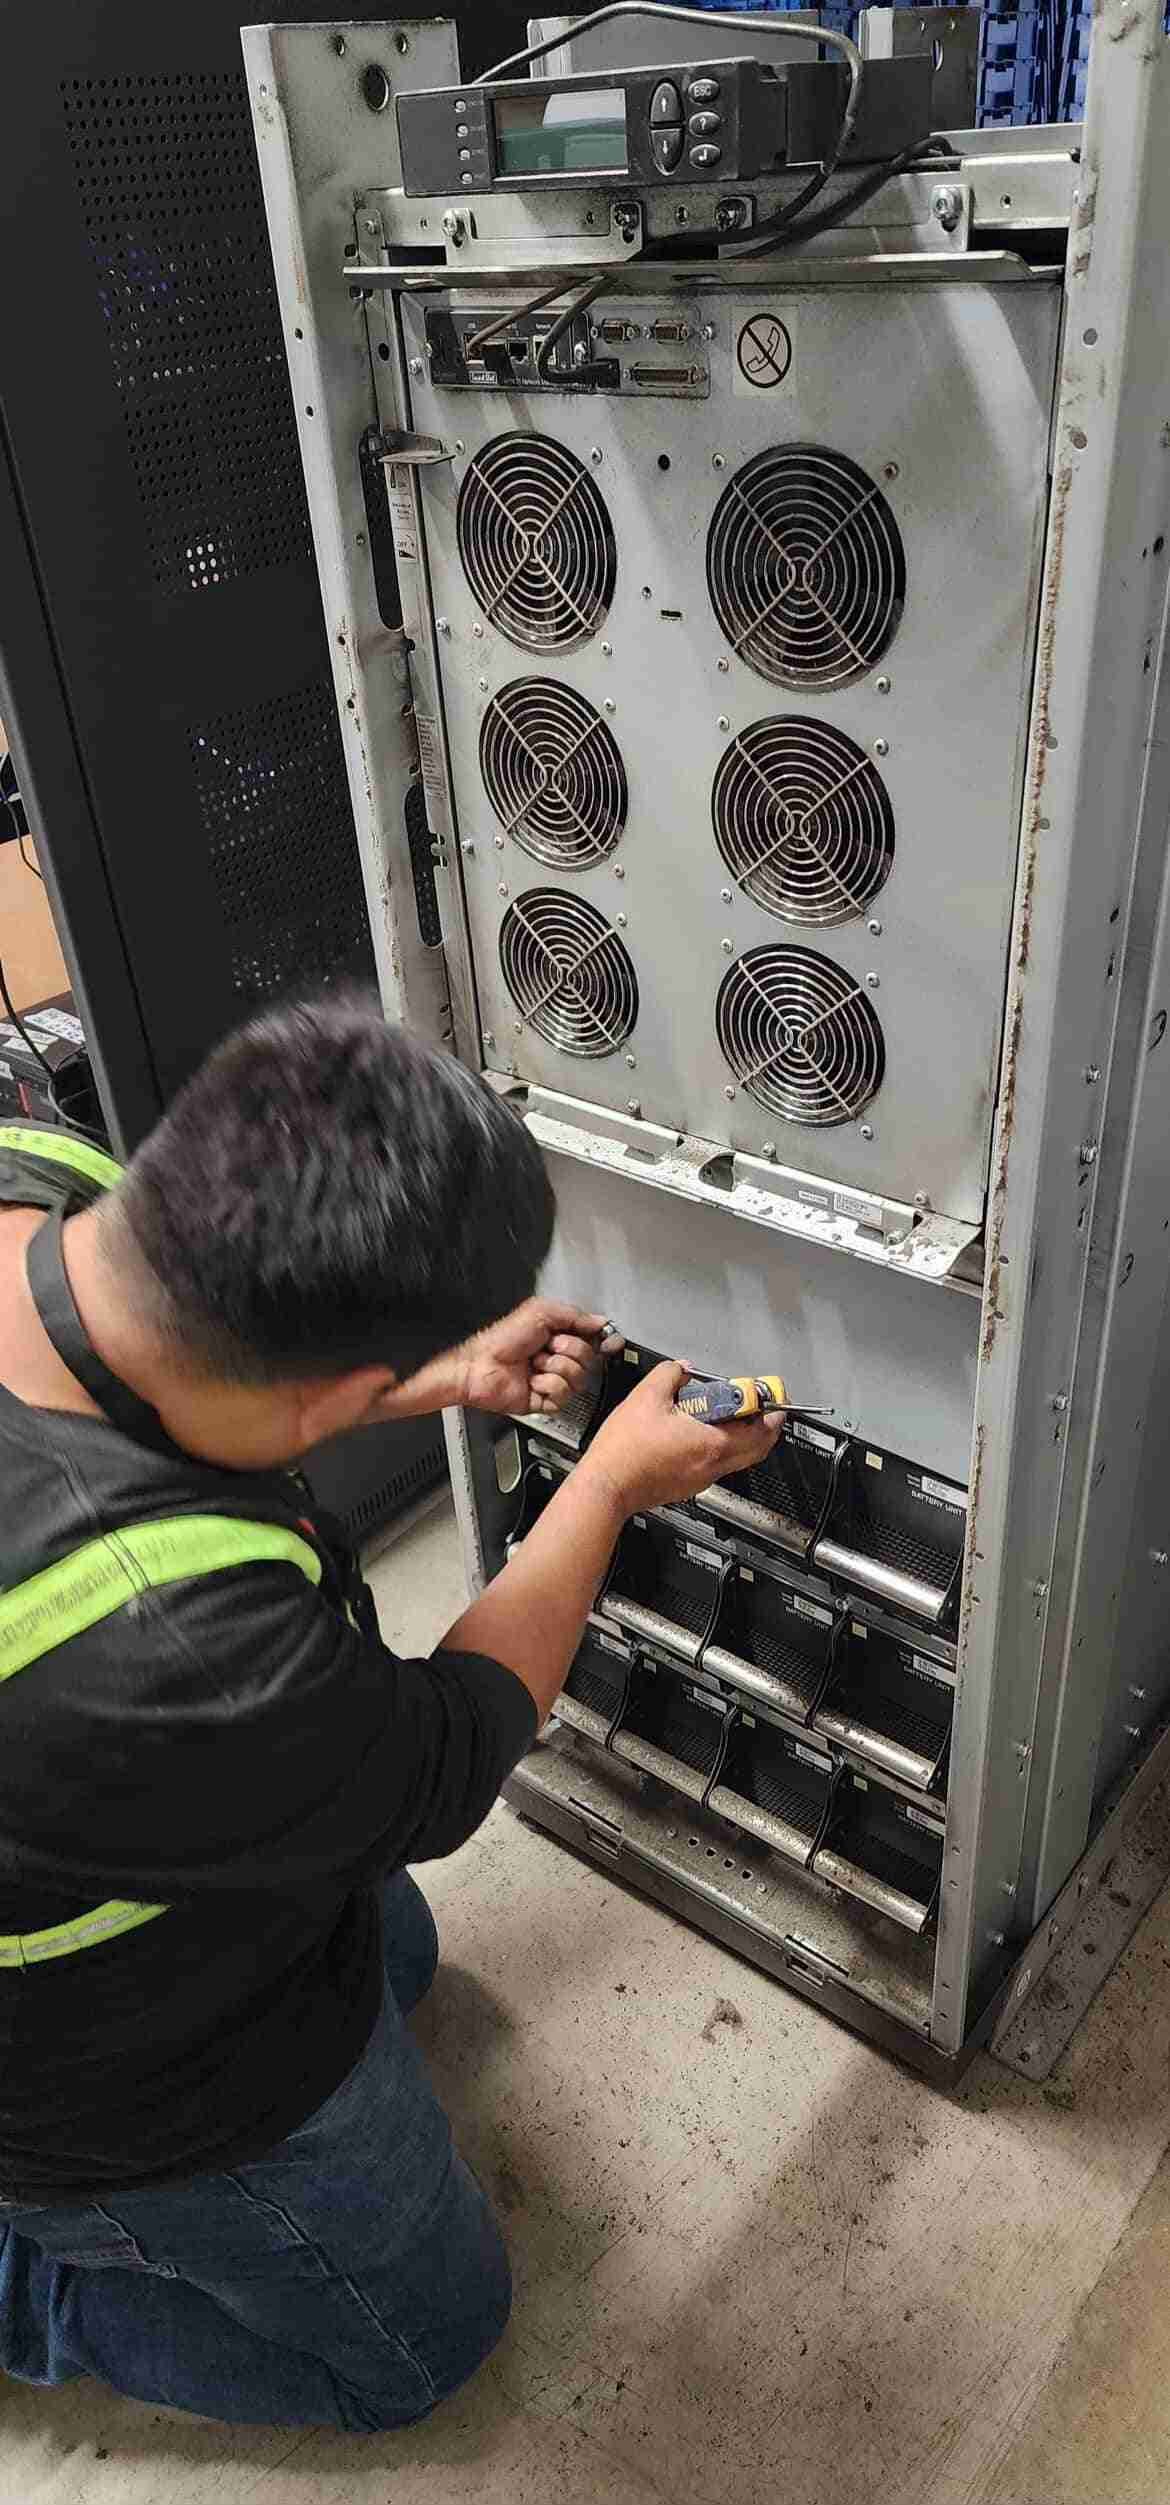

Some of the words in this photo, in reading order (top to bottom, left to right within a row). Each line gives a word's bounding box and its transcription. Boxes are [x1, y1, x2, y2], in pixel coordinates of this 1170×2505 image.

[693, 84, 712, 97] ESC
[785, 1434, 815, 1454] BATTERY
[815, 1447, 835, 1461] UNIT
[911, 1489, 944, 1510] BATTERY
[945, 1503, 965, 1517] UNIT
